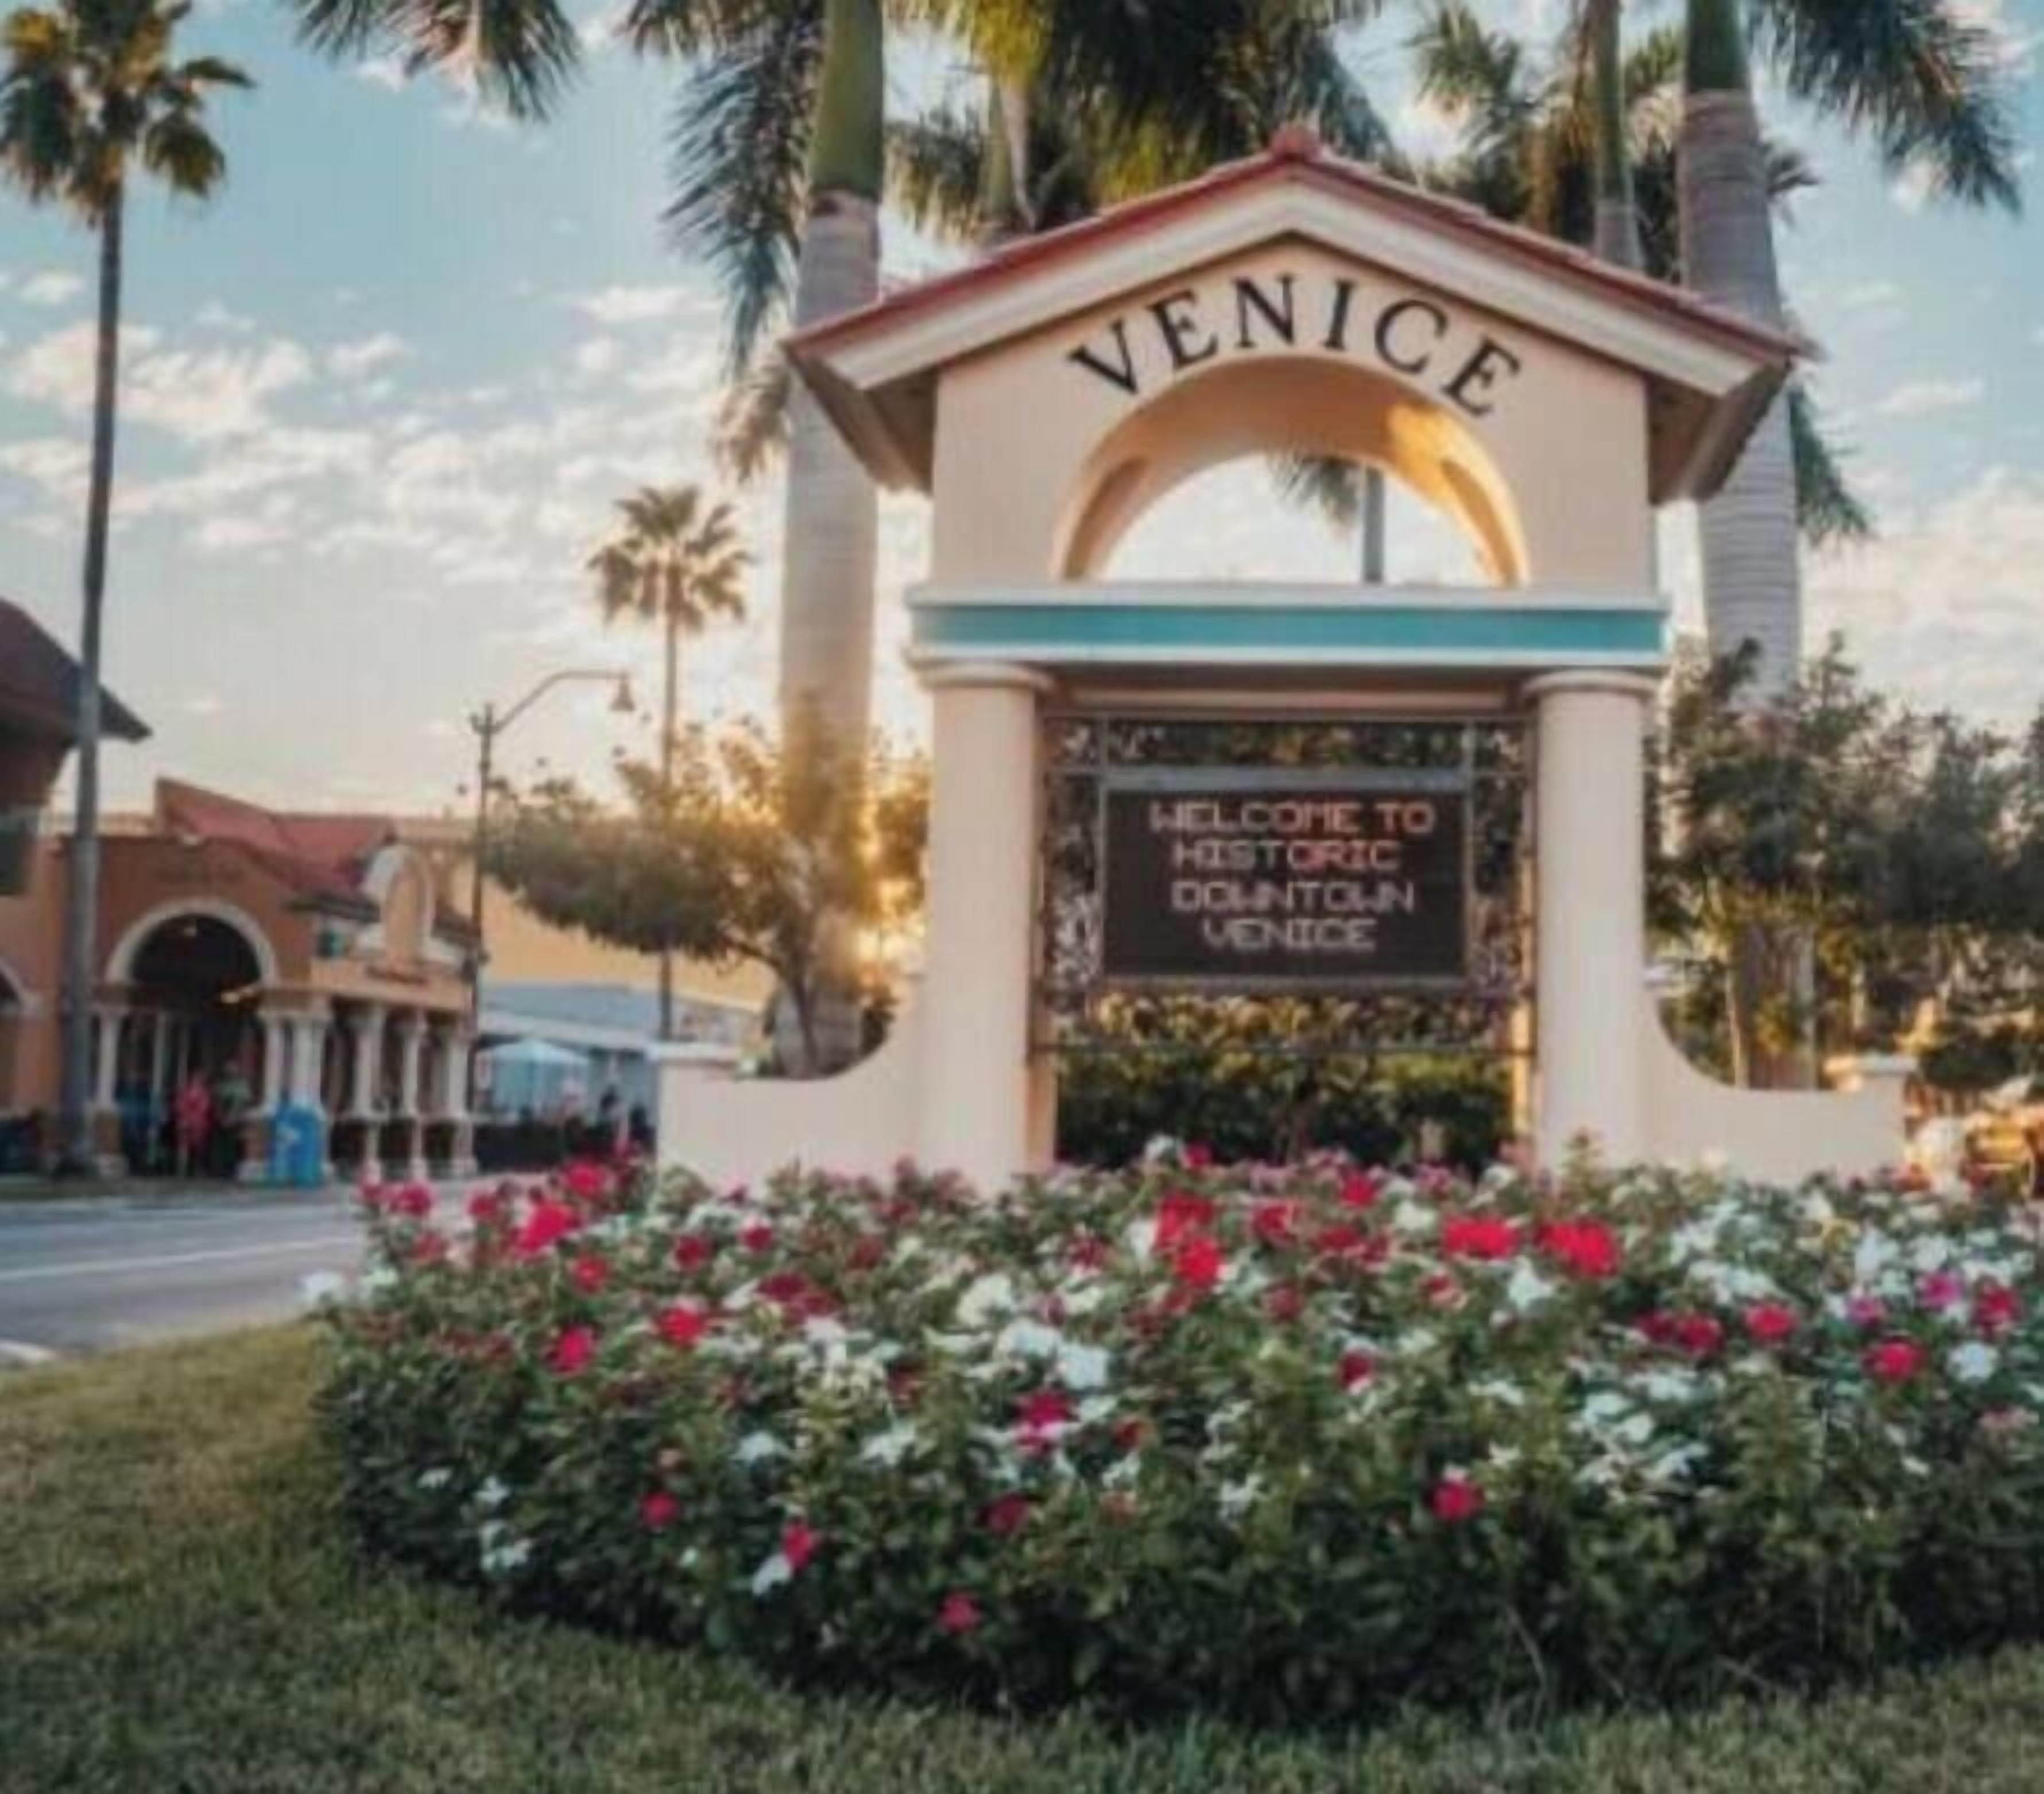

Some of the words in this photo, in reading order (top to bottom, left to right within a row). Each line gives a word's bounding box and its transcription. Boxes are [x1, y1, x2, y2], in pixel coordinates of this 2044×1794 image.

[1067, 272, 1522, 416] VENICE
[1151, 801, 1361, 833] WELCOME
[1375, 801, 1437, 833] TO
[1174, 838, 1402, 871] HISTORIC
[1170, 880, 1415, 913] DOWNTOWN
[1202, 918, 1378, 951] VENICE
